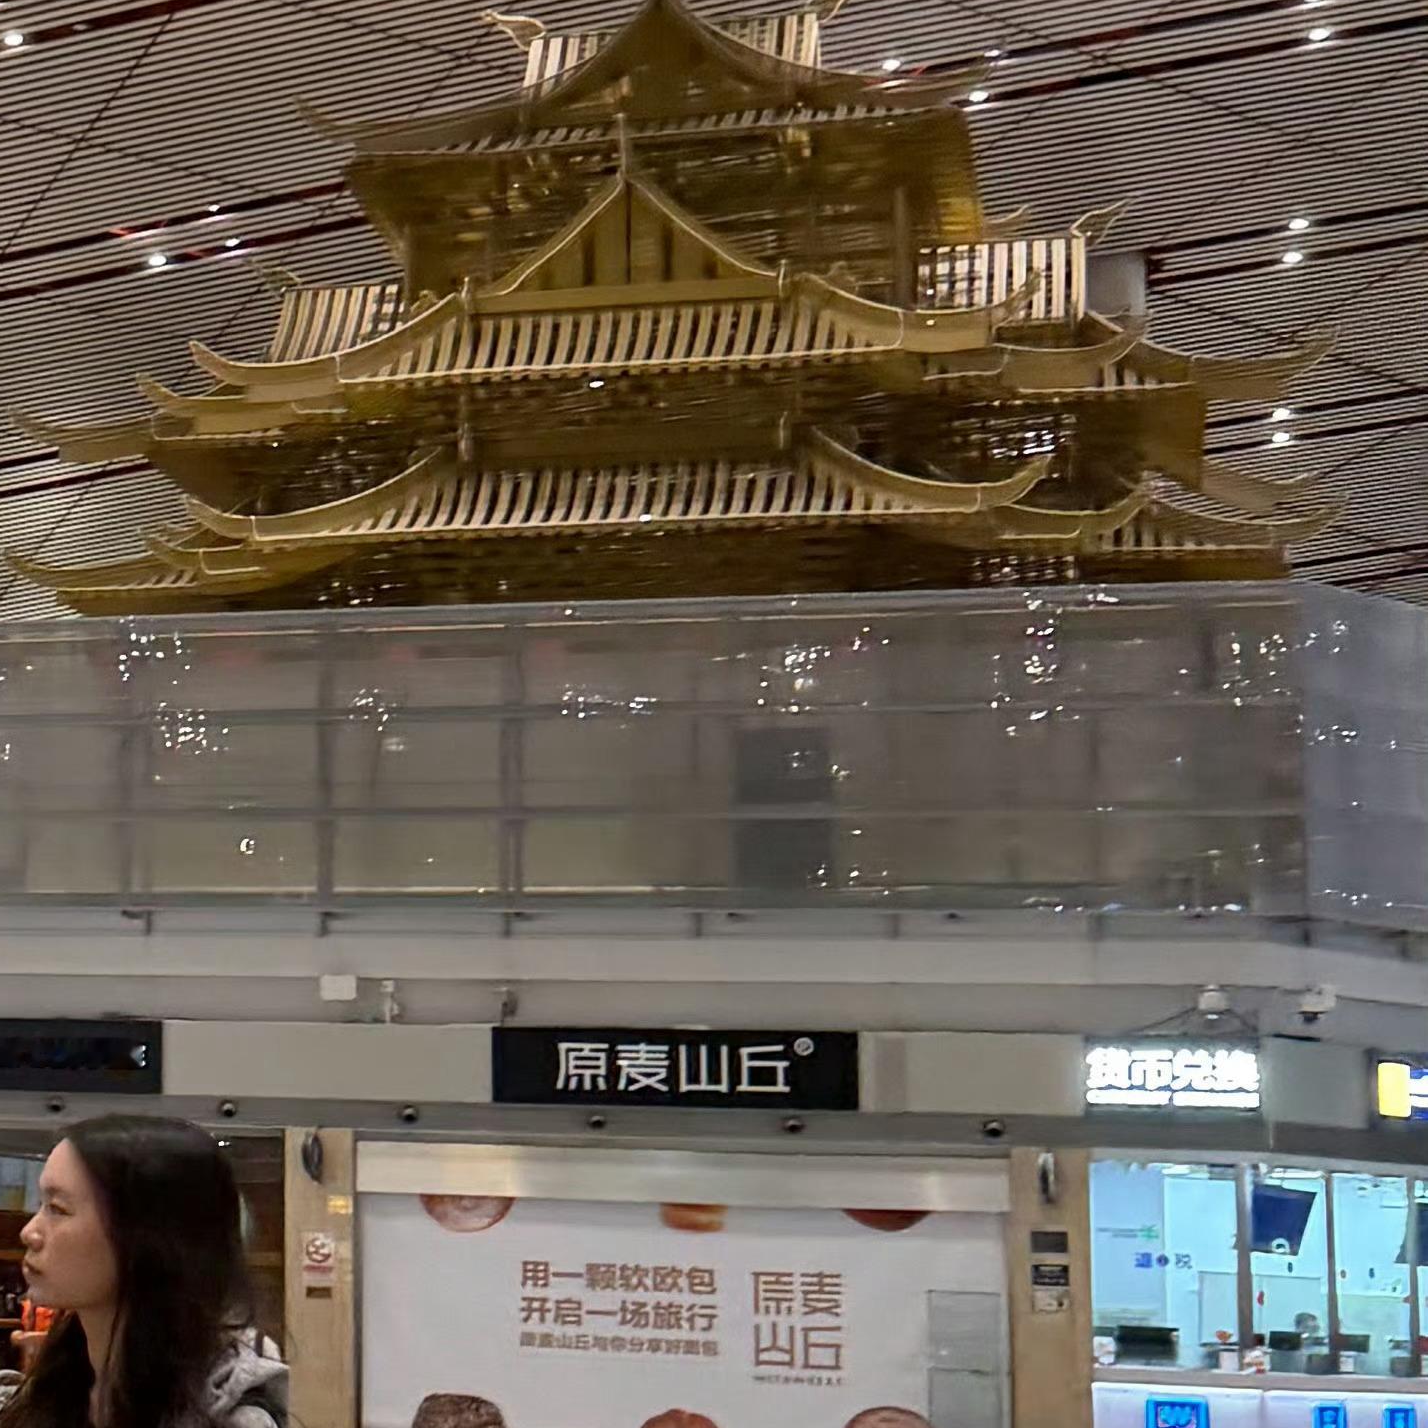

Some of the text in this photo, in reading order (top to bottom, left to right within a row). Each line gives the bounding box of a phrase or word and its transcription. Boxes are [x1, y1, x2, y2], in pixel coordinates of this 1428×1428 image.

[555, 1041, 792, 1094] 原麦山丘
[520, 1260, 718, 1294] 用一颗软欧包
[519, 1297, 719, 1332] 开启一场旅行
